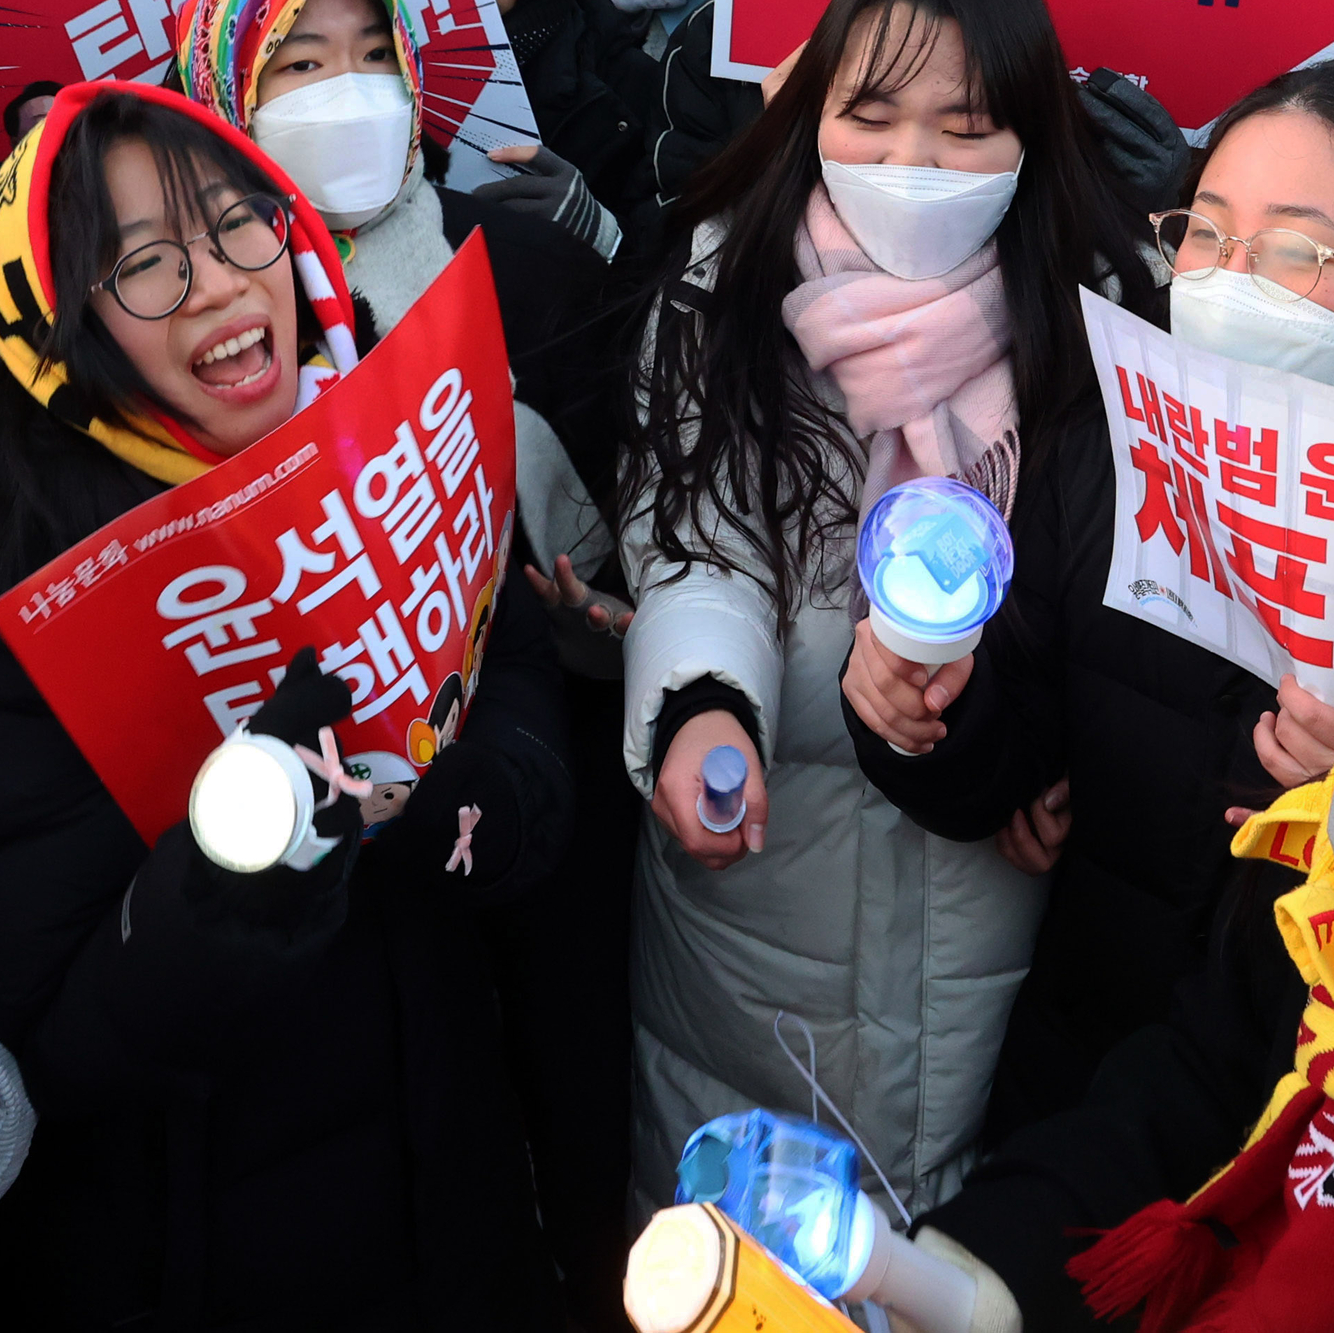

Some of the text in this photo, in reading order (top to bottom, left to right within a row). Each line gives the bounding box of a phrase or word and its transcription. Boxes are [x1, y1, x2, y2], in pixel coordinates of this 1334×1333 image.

[155, 367, 481, 676] 윤석열을
[1114, 364, 1279, 508] 내란범
[17, 441, 320, 626] 나눔문화 www.nanum.com
